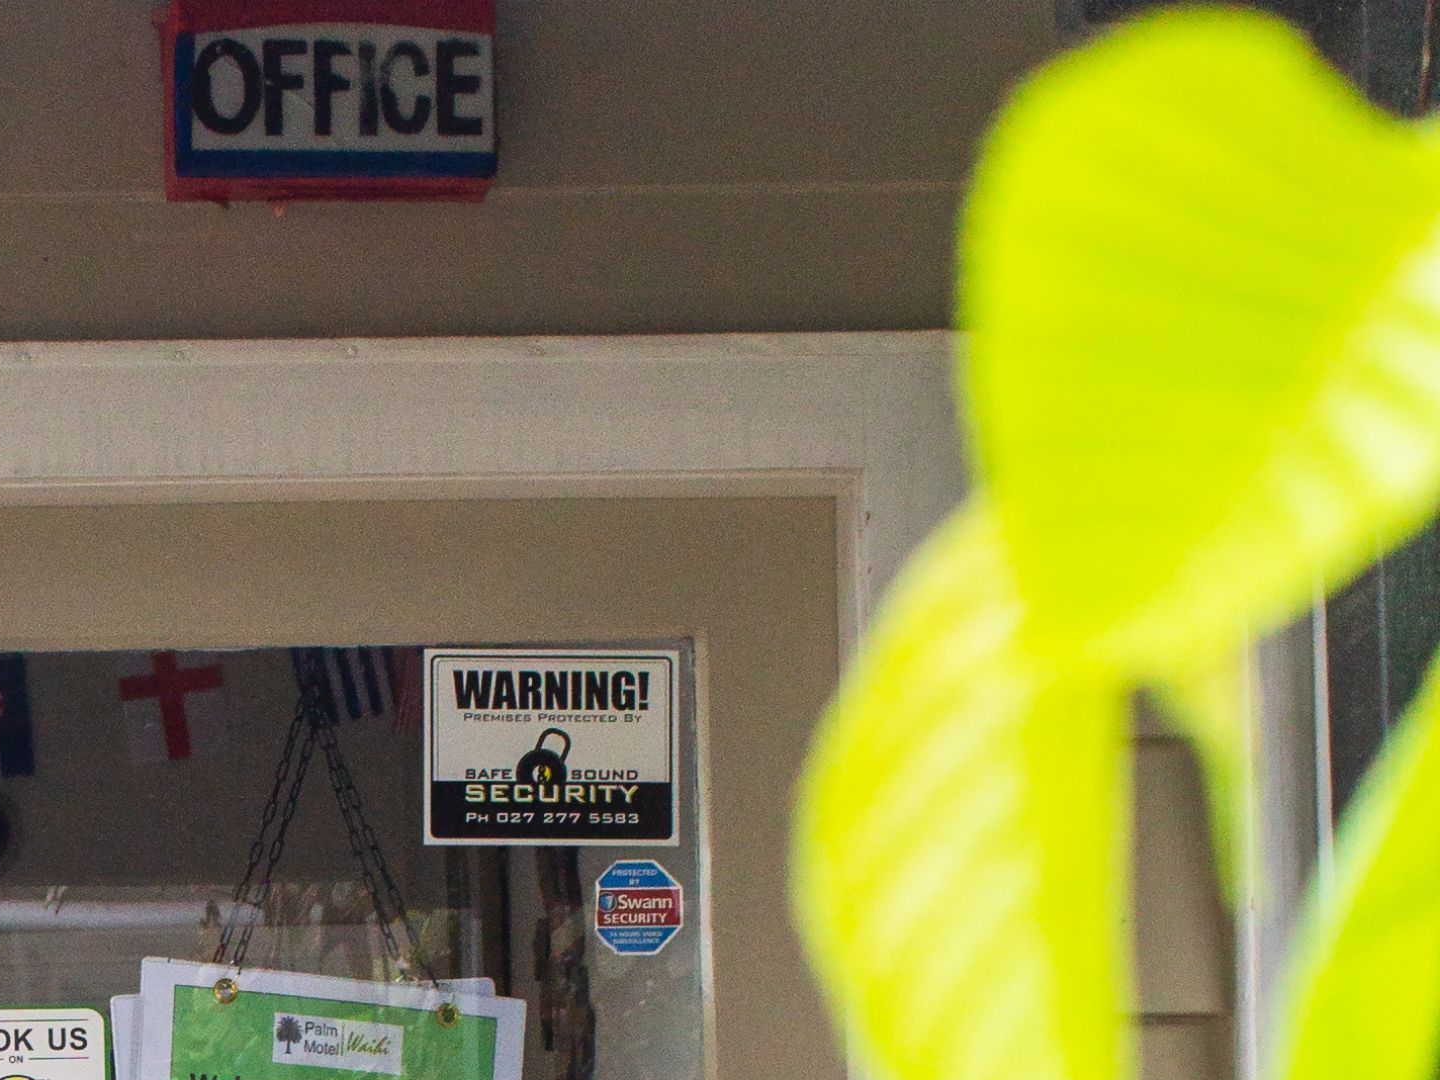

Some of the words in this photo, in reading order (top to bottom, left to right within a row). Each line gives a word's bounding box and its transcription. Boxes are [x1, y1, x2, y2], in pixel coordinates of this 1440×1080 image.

[191, 37, 483, 136] OFFICE
[453, 670, 650, 710] WARNING!
[463, 712, 531, 722] PREMISES
[538, 713, 617, 723] PROTECTED
[465, 768, 512, 780] SAFE
[571, 769, 638, 780] SOUND
[465, 784, 639, 803] SECURITY
[496, 812, 534, 823] 027
[543, 813, 581, 823] 277
[589, 813, 640, 824] 5583
[618, 894, 673, 910] Swann
[604, 912, 668, 924] SECURITY
[304, 1021, 338, 1037] Palm
[48, 1027, 88, 1051] US
[304, 1040, 339, 1056] Motel
[8, 1055, 24, 1064] ON
